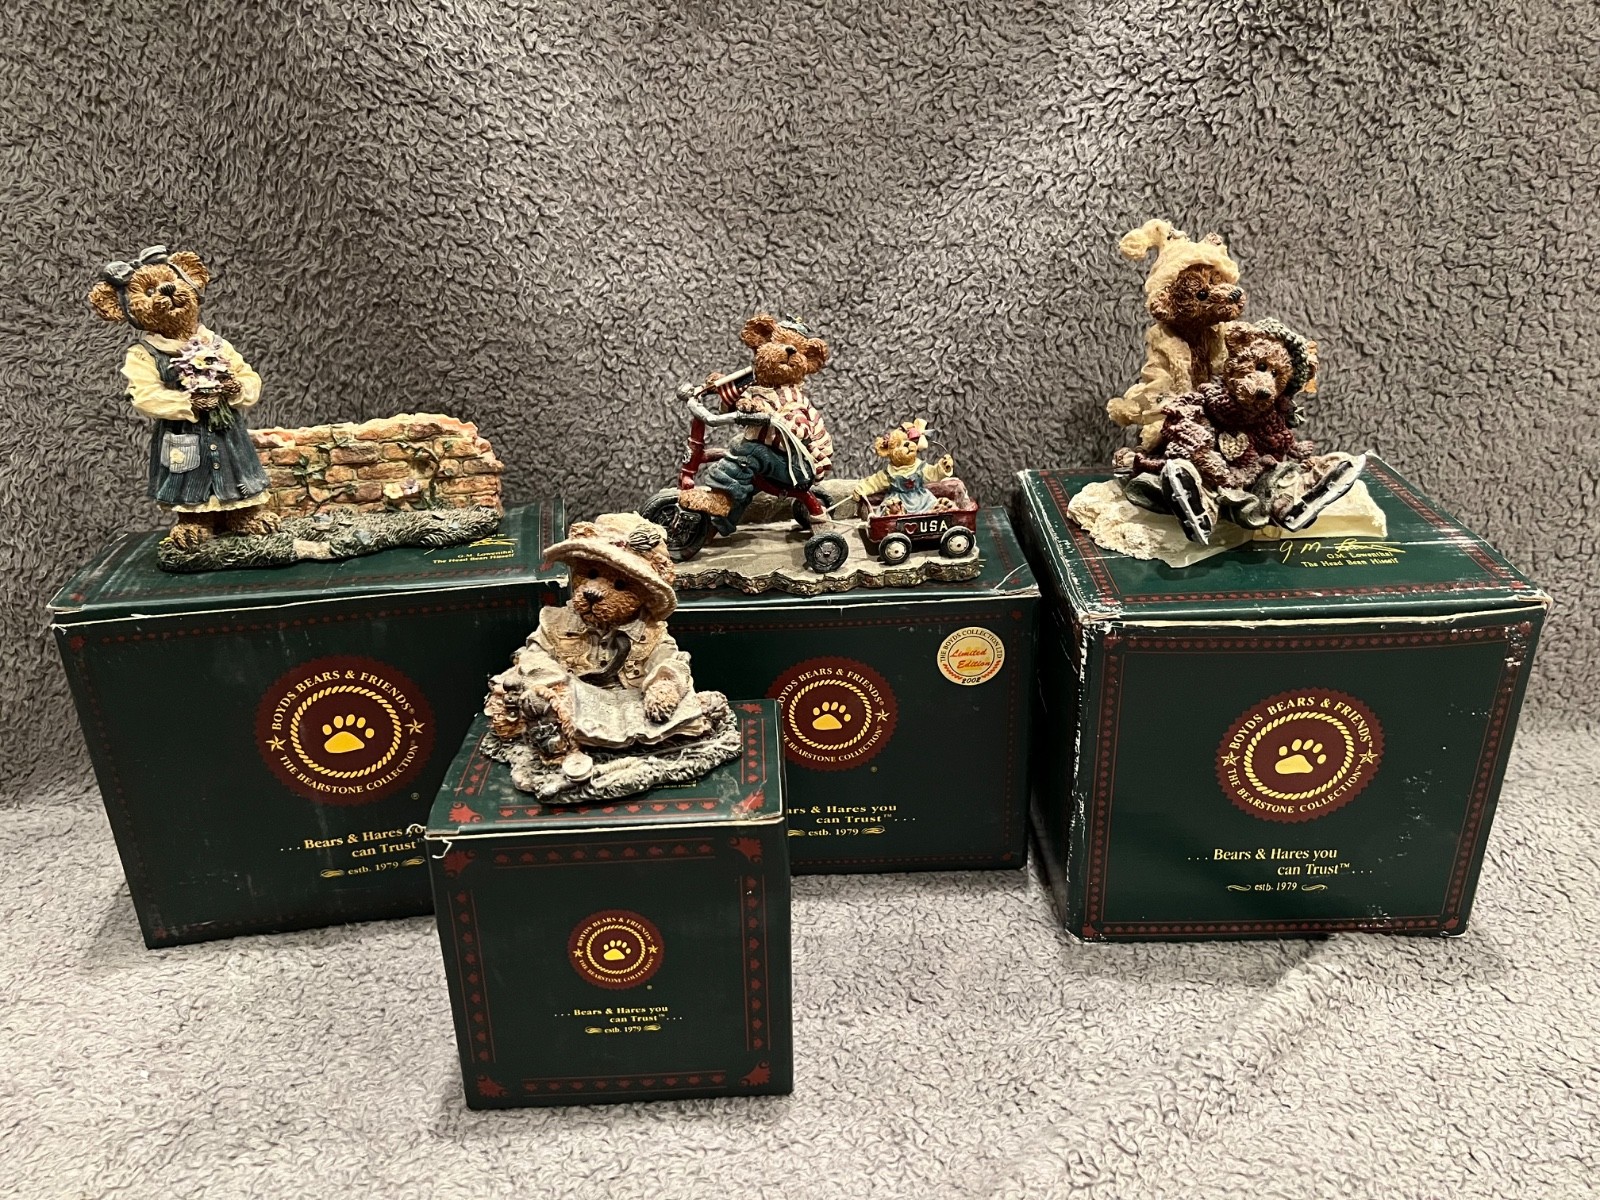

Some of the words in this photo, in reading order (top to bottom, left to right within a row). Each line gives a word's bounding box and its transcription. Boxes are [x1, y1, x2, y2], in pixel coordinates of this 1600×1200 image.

[920, 520, 948, 533] USA
[943, 633, 962, 650] BOYDS
[950, 648, 988, 658] Limited
[957, 660, 990, 669] Edition
[798, 667, 833, 682] BEARS
[836, 668, 844, 676] &
[271, 691, 297, 731] BOYDS
[295, 670, 340, 694] BEARS
[345, 670, 356, 680] &
[1228, 713, 1263, 750] BOYDS
[1267, 696, 1316, 716] BEARS
[1320, 698, 1331, 709] &
[788, 740, 836, 763] BEARSTONE
[279, 754, 298, 775] THE
[296, 772, 364, 794] BEARSTONE
[1227, 769, 1240, 788] THE
[1236, 788, 1295, 814] BEARSTONE
[810, 806, 821, 814] &
[826, 806, 867, 814] Hares
[872, 806, 897, 814] you
[304, 838, 344, 850] Bears
[347, 834, 359, 844] &
[362, 828, 403, 842] Hares
[408, 827, 424, 837] yo
[808, 828, 832, 836] estb.
[836, 828, 860, 836] 1979
[352, 847, 376, 858] can
[1213, 848, 1251, 860] Bears
[1255, 848, 1266, 860] &
[1270, 848, 1310, 860] Hares
[1312, 848, 1338, 862] you
[348, 866, 372, 876] estb.
[375, 862, 399, 872] 1979
[1277, 865, 1300, 876] can
[1254, 881, 1274, 891] estb.
[1276, 881, 1298, 891] 1979
[577, 926, 592, 946] BOYDS
[592, 917, 616, 927] BEARS
[588, 969, 622, 983] BEARSTONE
[574, 1008, 602, 1016] Bears
[616, 1006, 646, 1014] Hares
[649, 1006, 668, 1014] you
[610, 1016, 628, 1024] can
